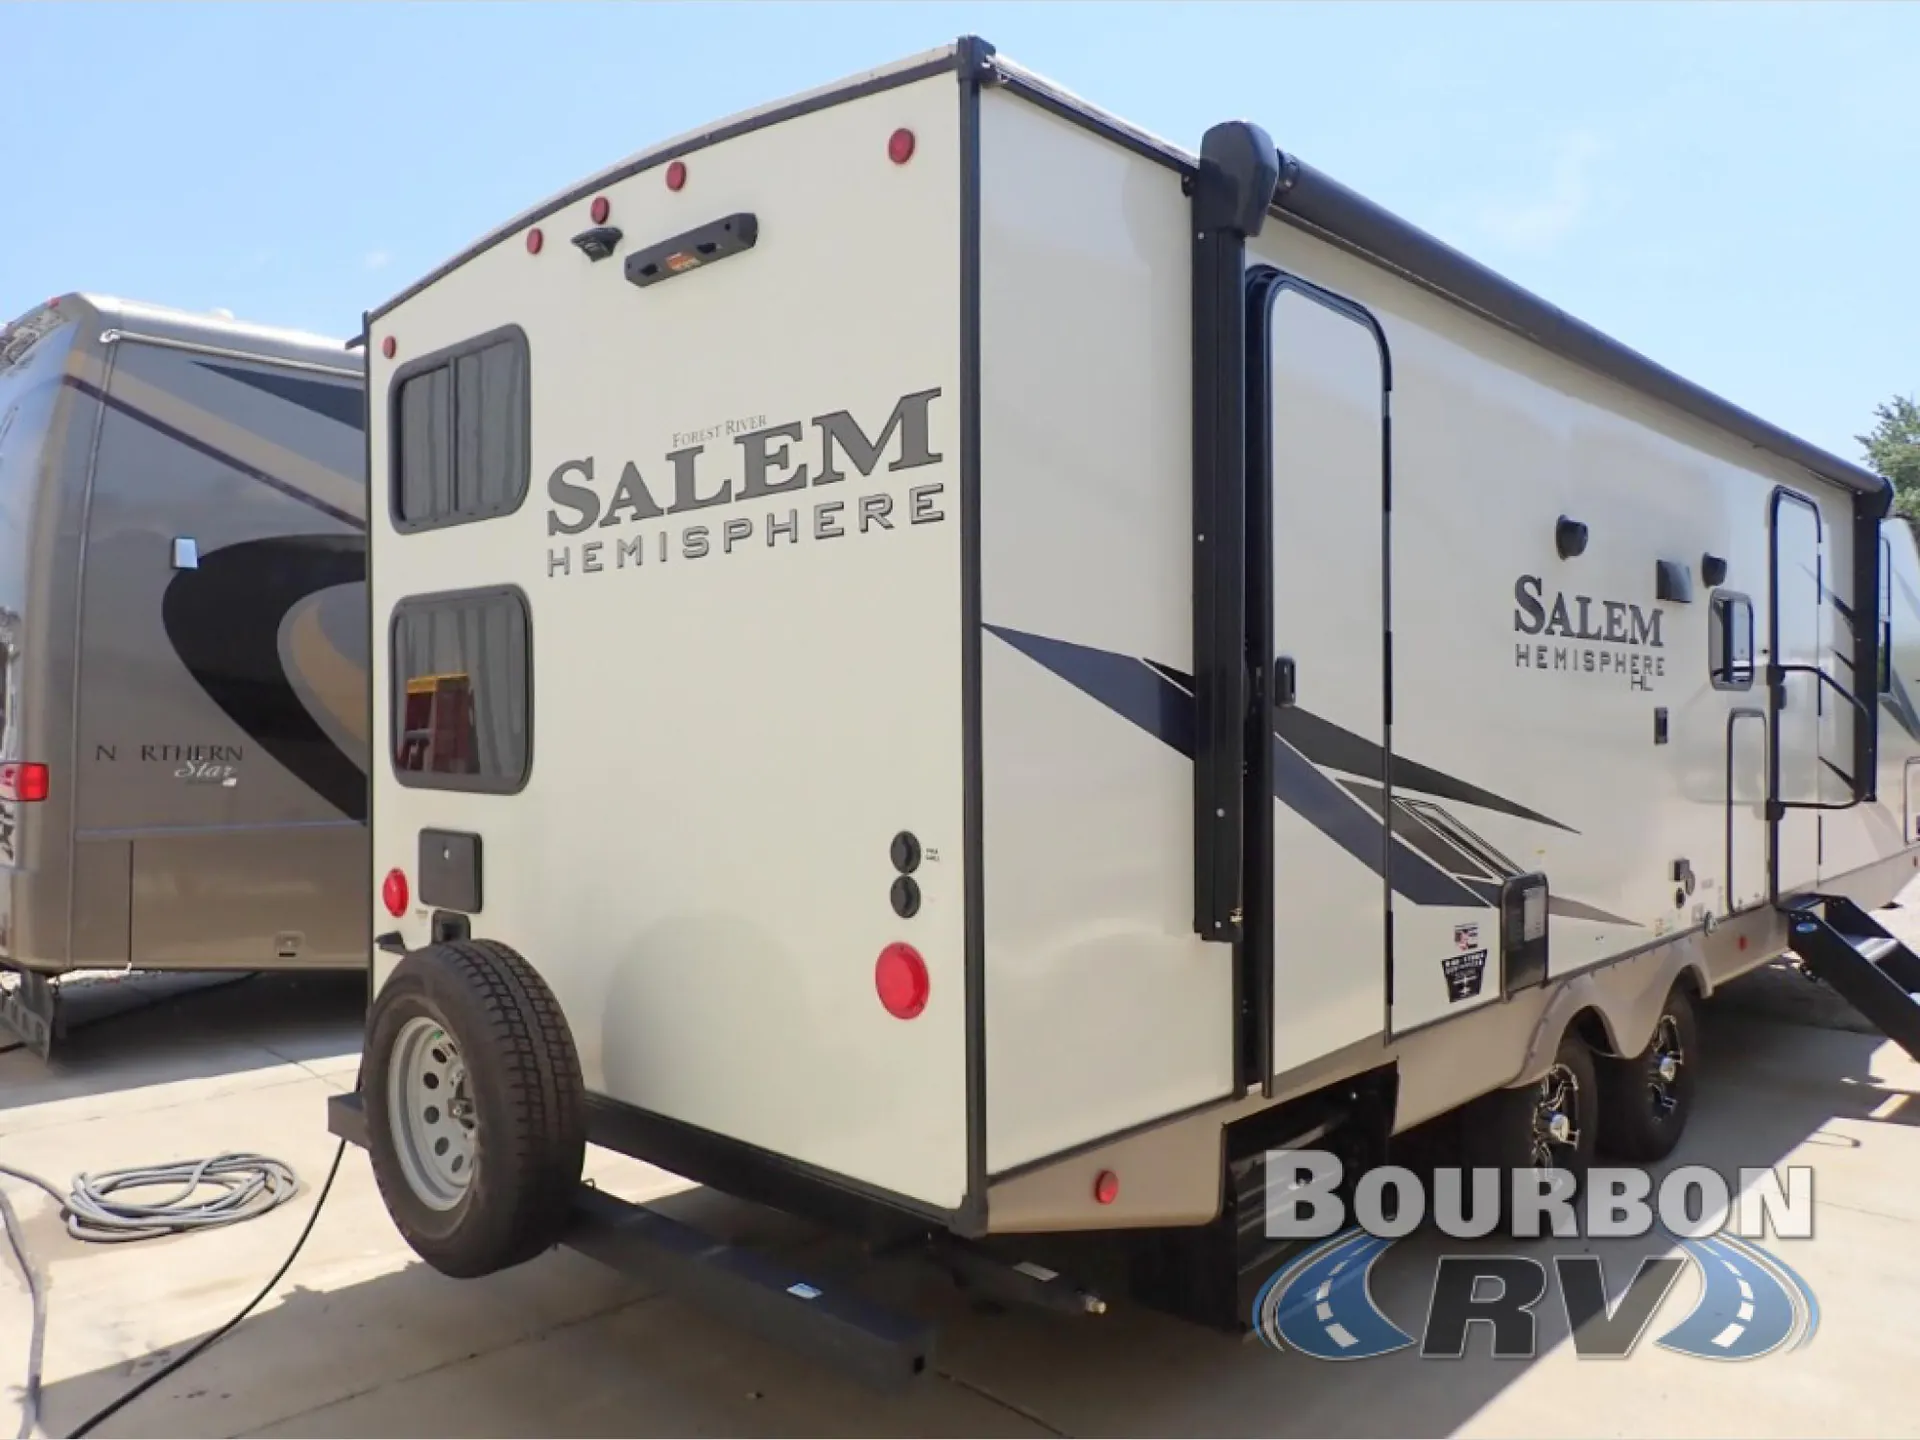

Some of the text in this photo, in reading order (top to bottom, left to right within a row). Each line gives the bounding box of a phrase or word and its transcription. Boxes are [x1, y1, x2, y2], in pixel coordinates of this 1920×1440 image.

[672, 414, 767, 448] FOREST RIVER
[547, 386, 943, 537] SALEM
[547, 483, 945, 577] HEMISPHERE
[1514, 574, 1664, 647] SALEM
[1515, 643, 1665, 677] HEMISPHERE
[1630, 675, 1654, 692] HL
[96, 743, 244, 762] NRTHERN
[174, 756, 233, 778] Star
